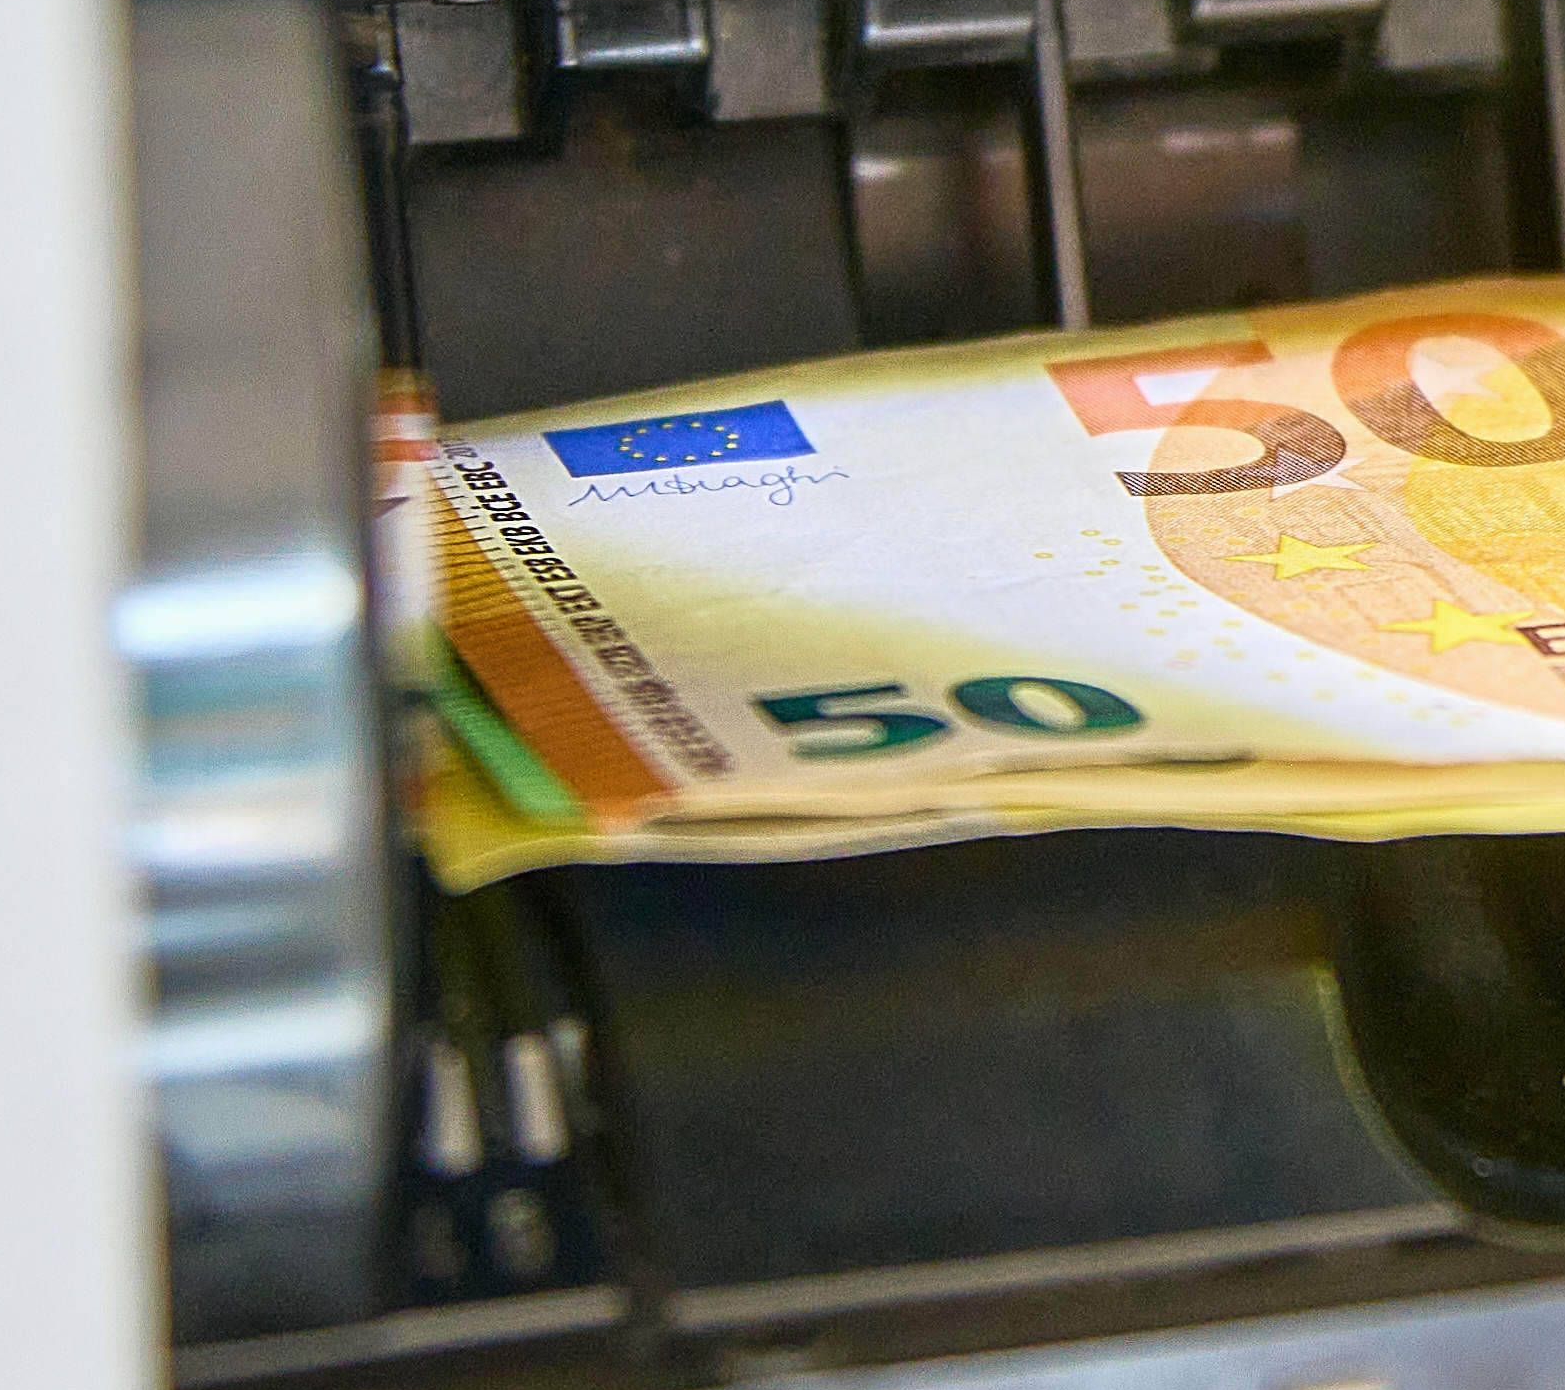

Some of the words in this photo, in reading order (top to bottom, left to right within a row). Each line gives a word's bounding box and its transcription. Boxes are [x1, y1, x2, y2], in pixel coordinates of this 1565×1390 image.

[454, 461, 508, 491] EBC
[499, 525, 556, 555] EKB
[751, 675, 1146, 764] 50
